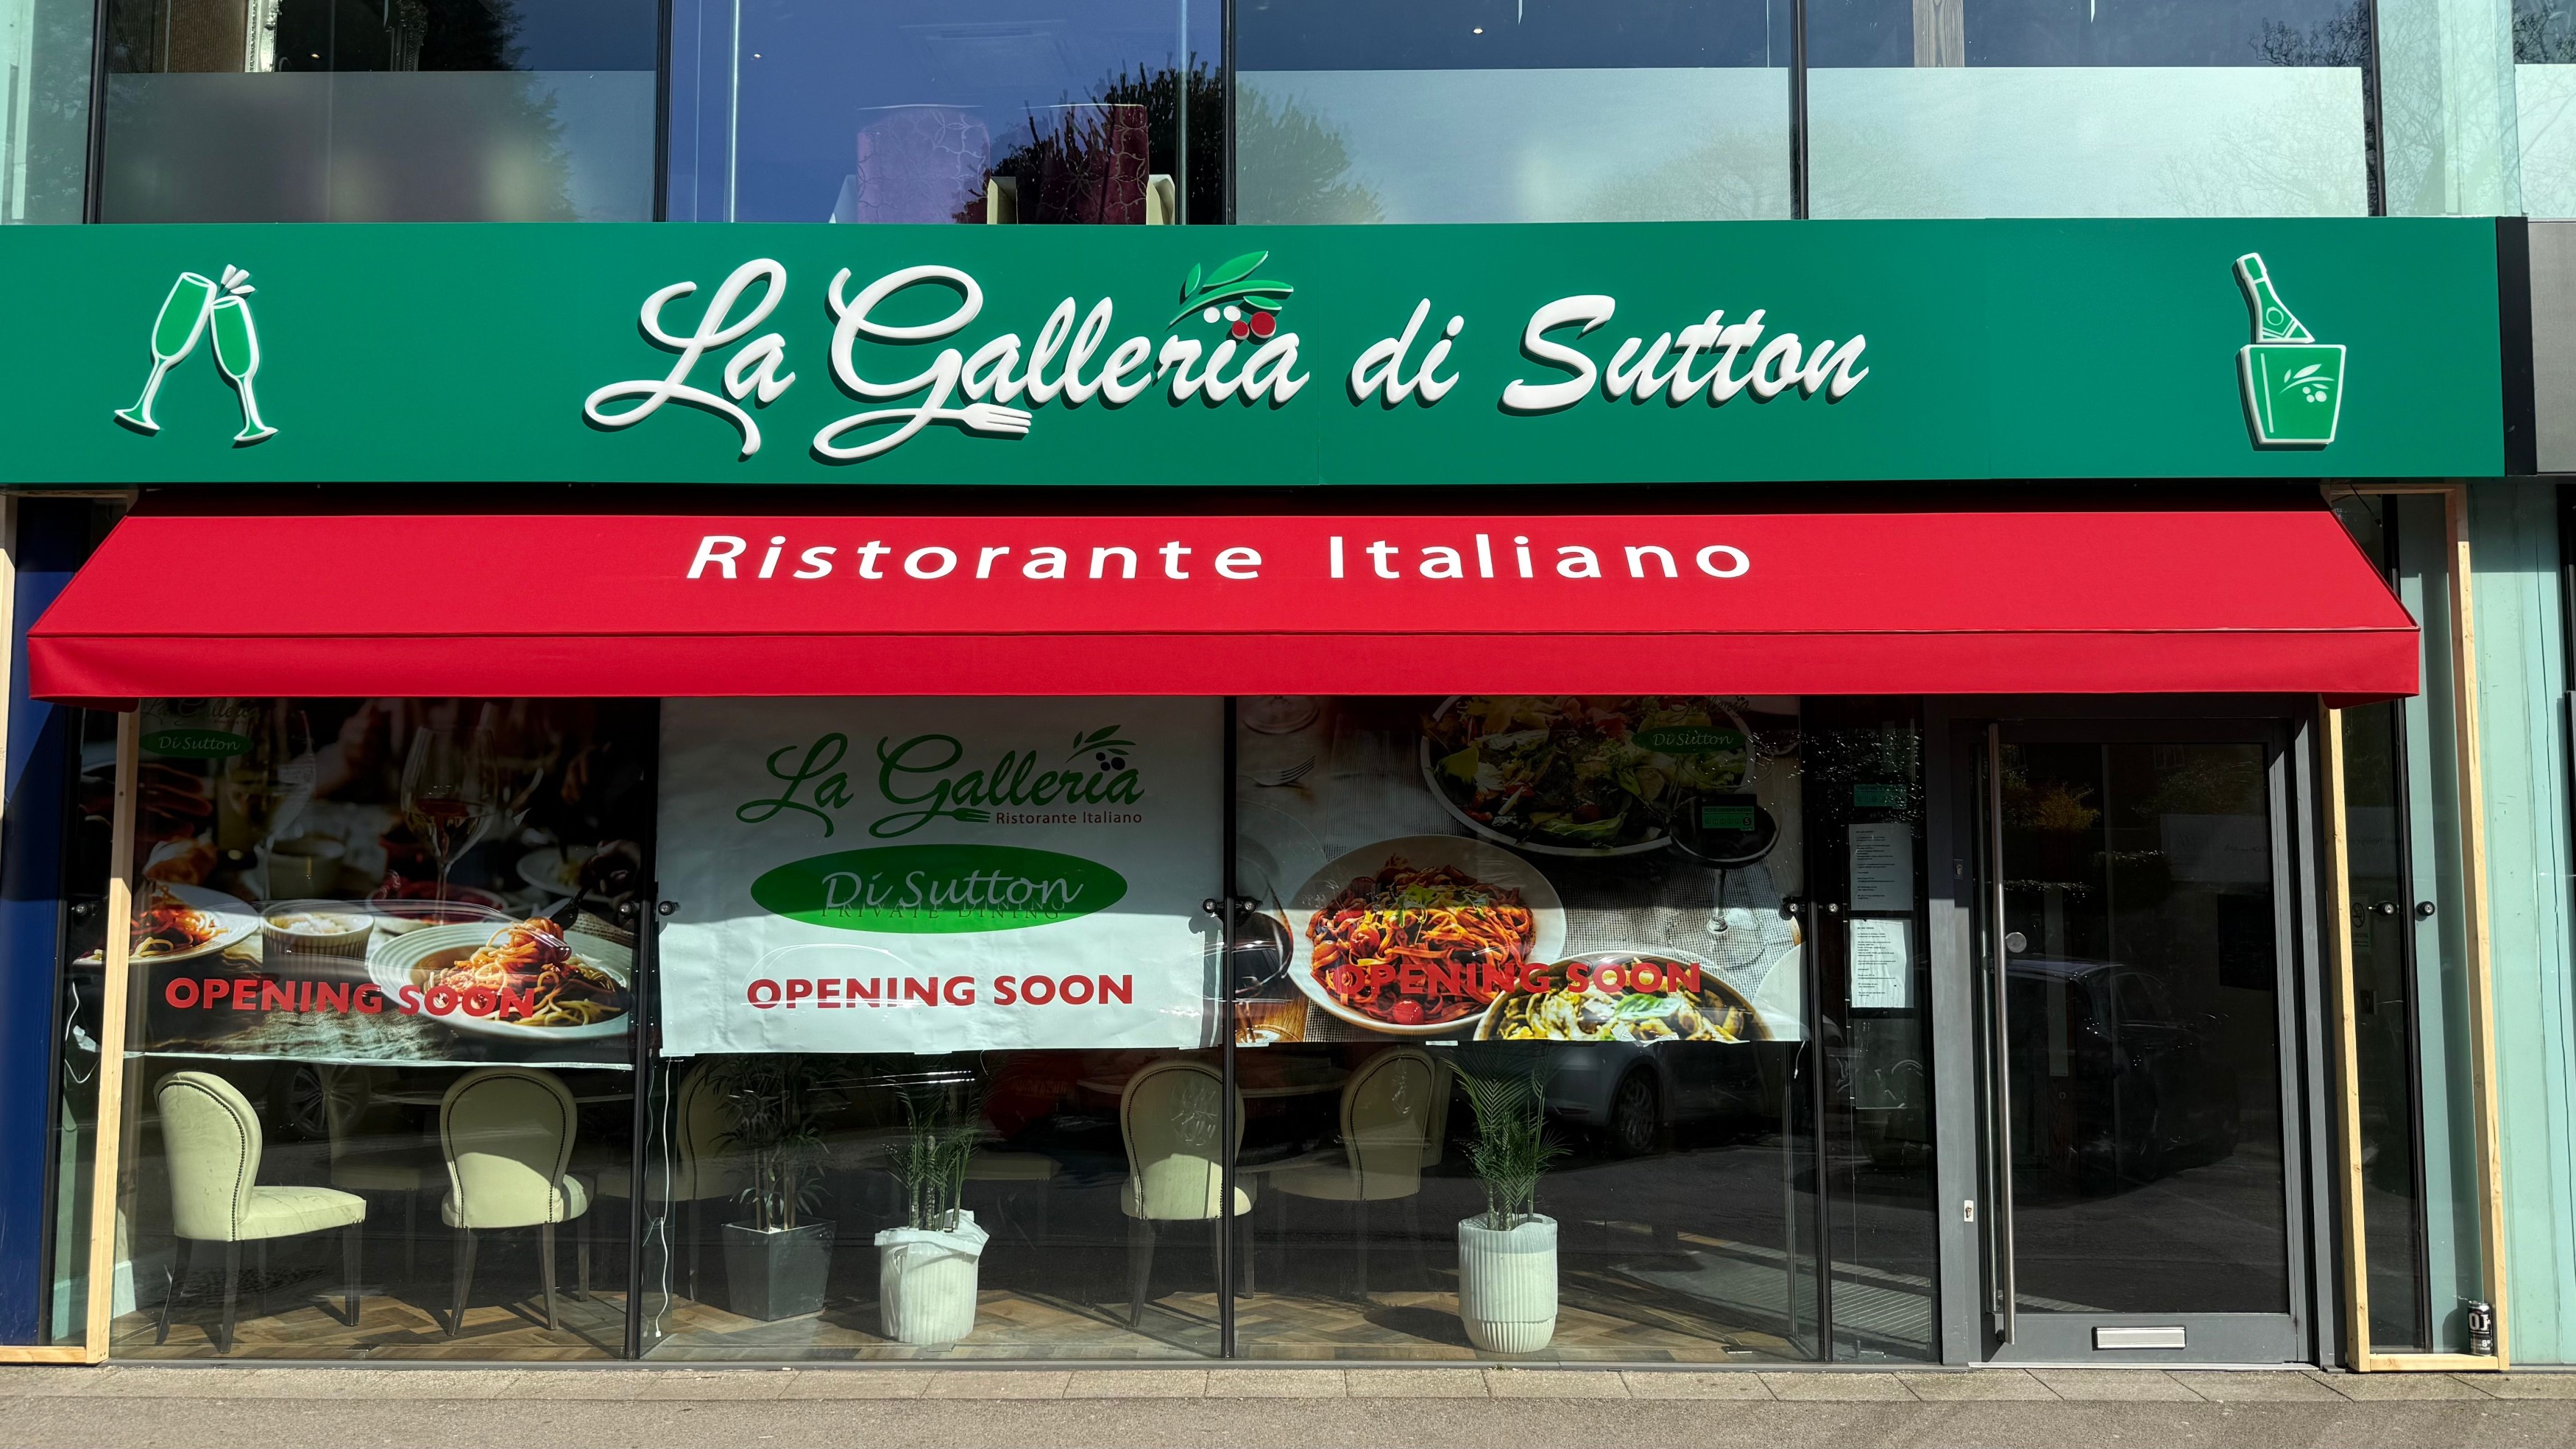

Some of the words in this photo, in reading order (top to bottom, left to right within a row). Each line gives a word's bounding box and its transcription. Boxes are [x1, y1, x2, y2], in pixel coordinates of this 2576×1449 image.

[584, 258, 796, 456] La
[813, 265, 1309, 459] Galleria
[1351, 297, 1465, 403] di
[1501, 294, 1869, 410] Sutton
[686, 535, 1262, 580] Ristorante
[1330, 534, 1751, 580] Italiano
[159, 736, 182, 749] Di
[182, 737, 241, 751] Sutton
[1652, 733, 1675, 746] Di
[1676, 733, 1734, 746] Sutton
[736, 732, 854, 837] La
[868, 734, 1145, 838] Galleria
[996, 811, 1078, 825] Ristorante
[1083, 811, 1143, 824] Italiano
[821, 871, 894, 908] Di
[899, 869, 1083, 907] Sutton
[959, 896, 1066, 918] DINING
[747, 976, 976, 1009] OPENING
[994, 974, 1133, 1005] SOON
[1332, 963, 1550, 995] OPENING
[1567, 963, 1700, 993] SOON
[165, 977, 383, 1014] OPENING
[398, 985, 535, 1018] SOON
